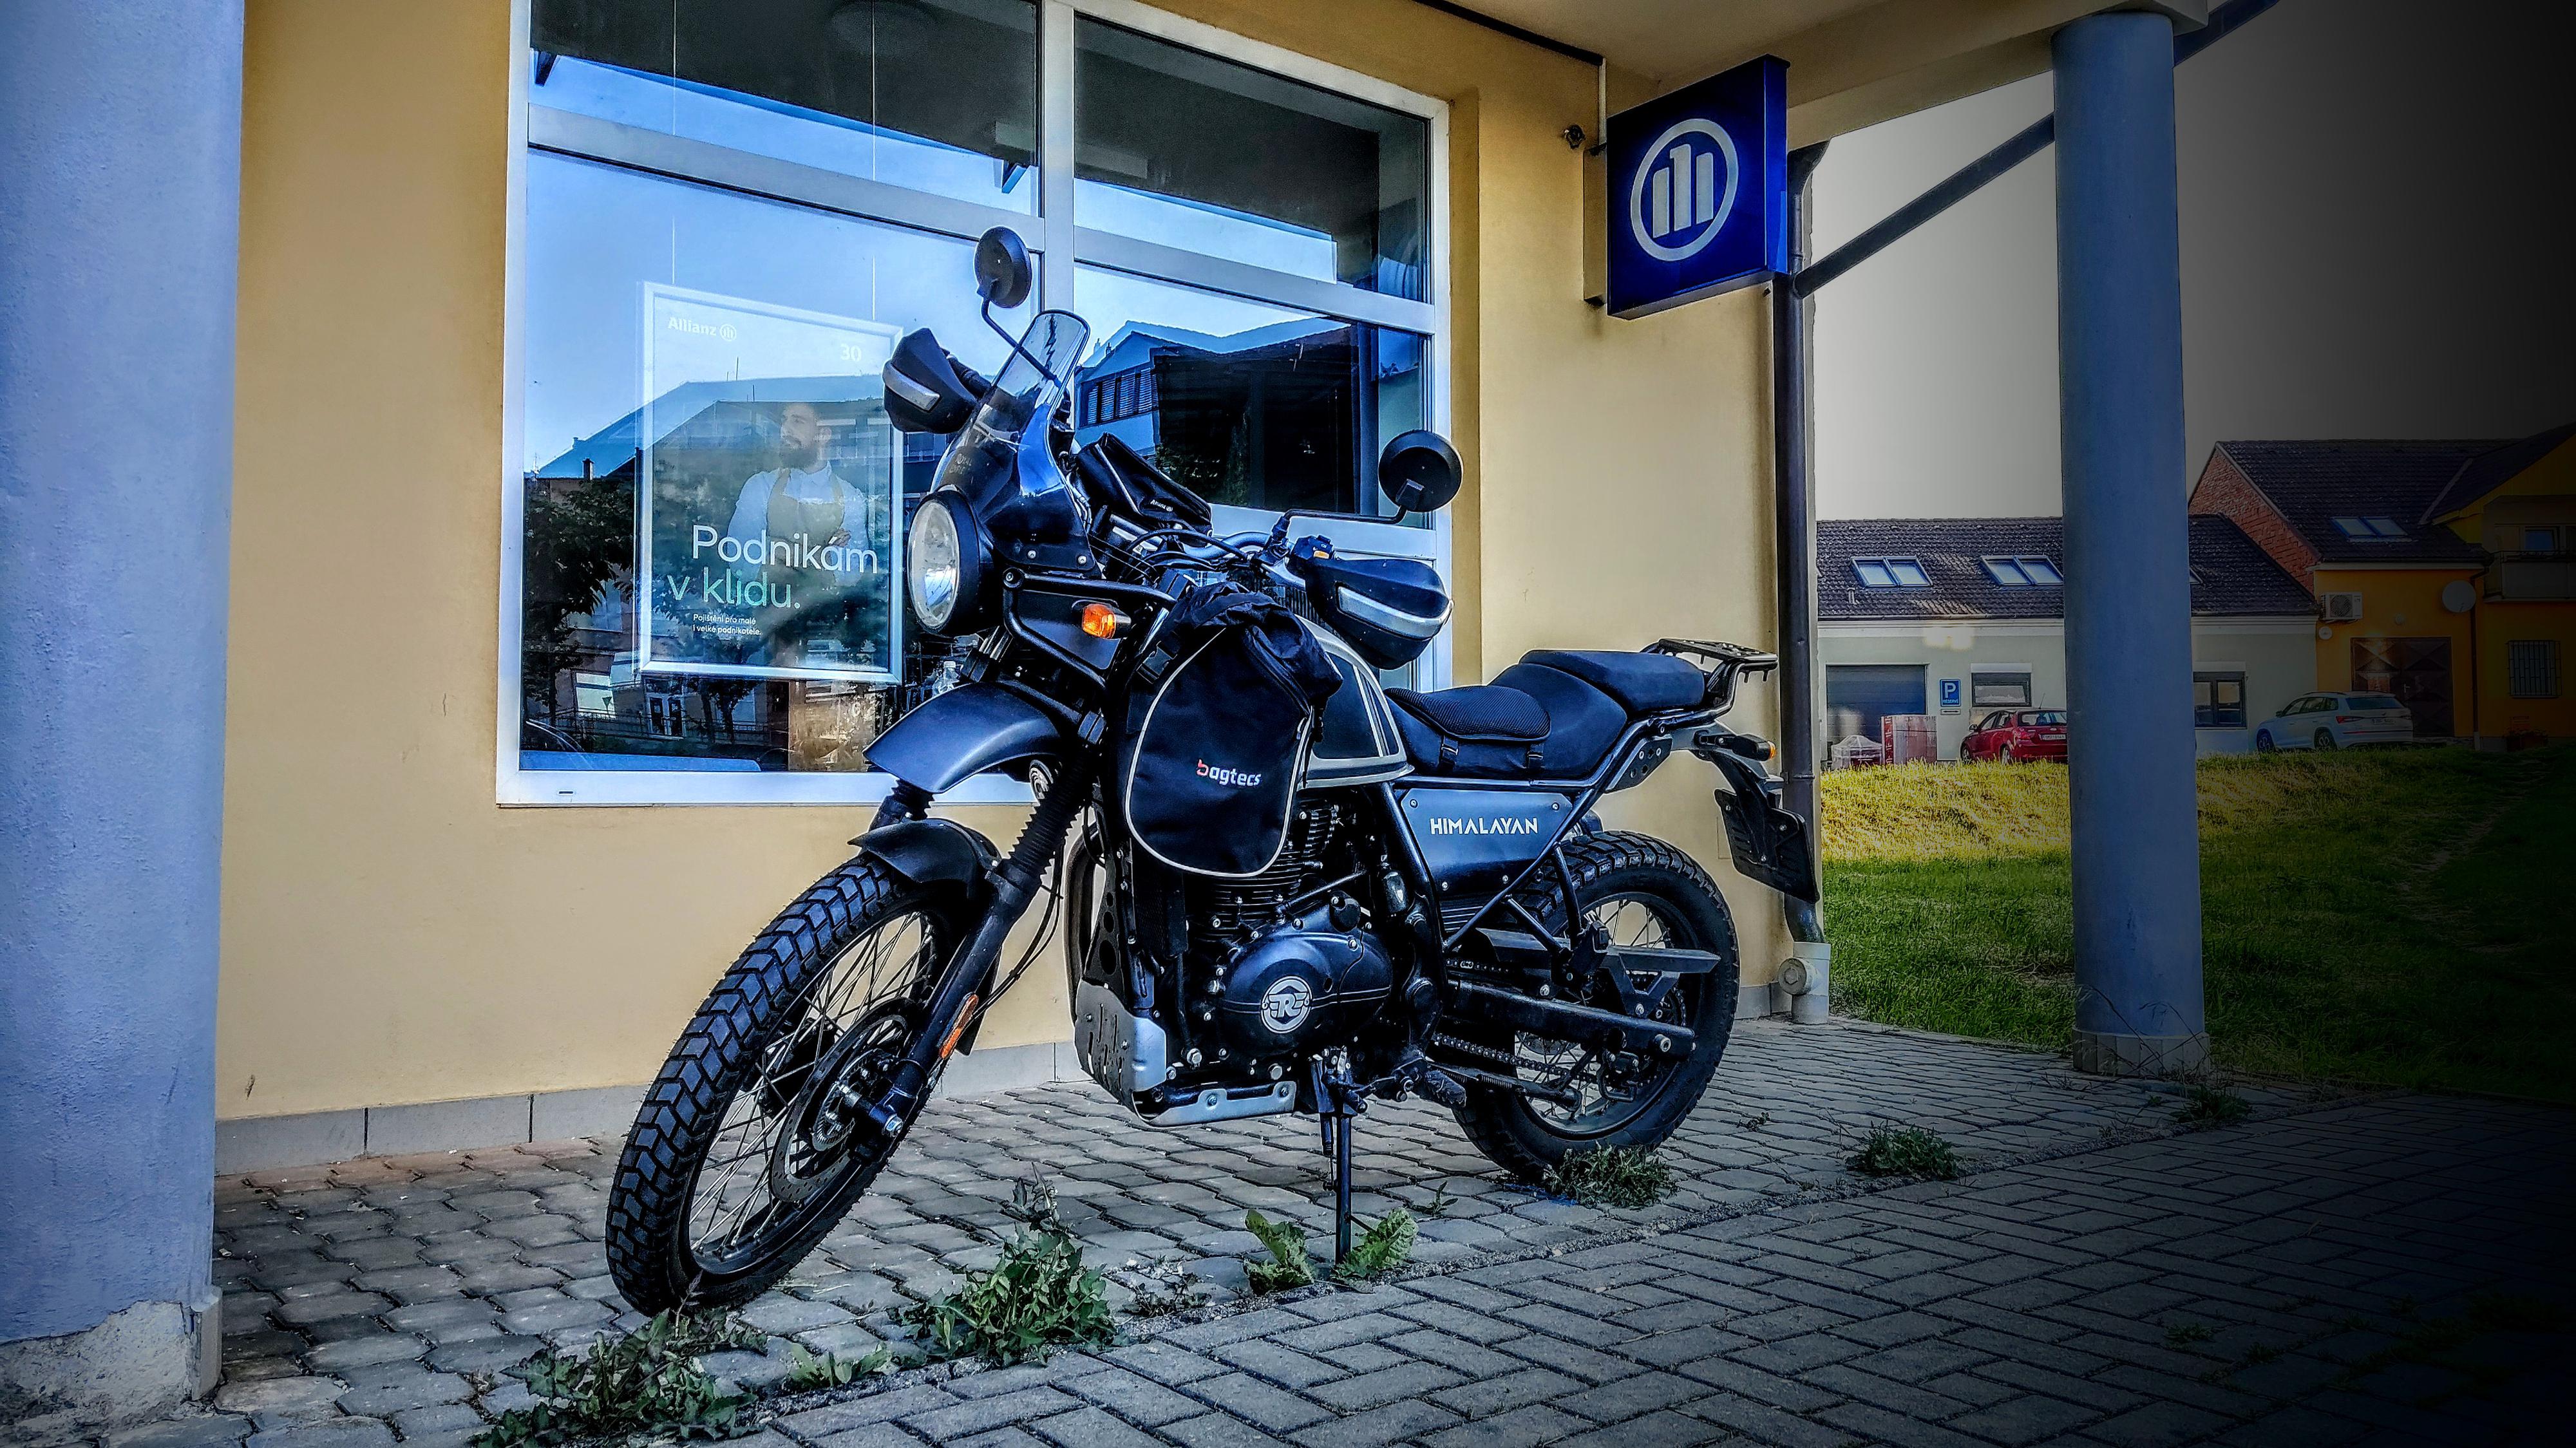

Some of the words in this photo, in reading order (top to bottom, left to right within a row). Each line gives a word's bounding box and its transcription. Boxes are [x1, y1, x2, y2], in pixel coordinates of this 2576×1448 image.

[668, 317, 717, 336] Allianz
[840, 343, 862, 362] 30
[692, 525, 878, 574] Podnikám
[667, 575, 690, 600] v
[703, 567, 800, 609] klidu.
[696, 625, 717, 633] velké
[738, 617, 757, 625] malé
[1945, 682, 1956, 698] P
[1197, 759, 1262, 786] bagtecs
[1430, 818, 1538, 834] HIMALAYAN
